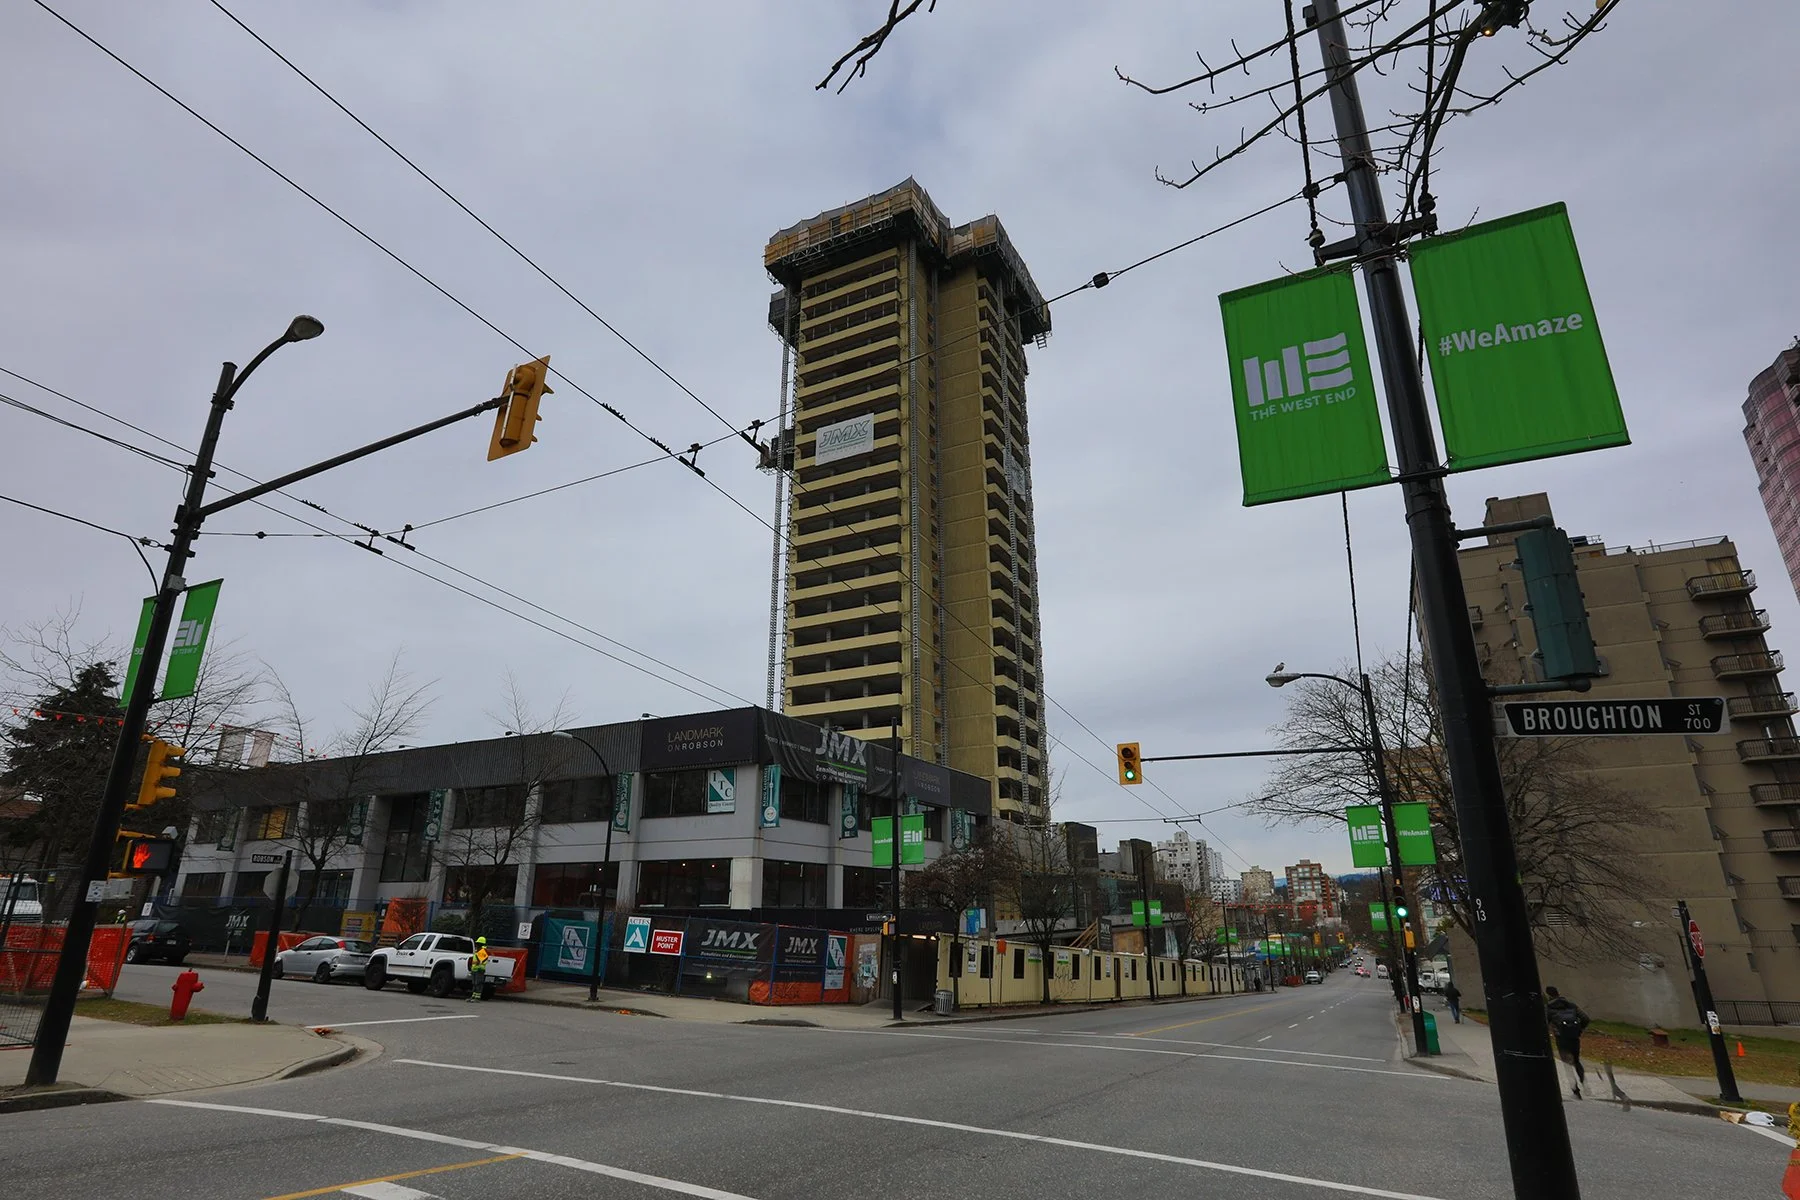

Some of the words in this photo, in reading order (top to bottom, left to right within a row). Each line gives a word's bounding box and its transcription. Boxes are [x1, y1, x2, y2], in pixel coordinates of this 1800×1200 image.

[1438, 312, 1584, 357] #WeAmaze
[1249, 404, 1277, 421] THE
[1280, 395, 1321, 413] WEST
[1325, 387, 1356, 405] END
[819, 420, 870, 448] JMX
[1522, 704, 1662, 731] BROUGHTON
[1688, 704, 1701, 716] ST
[1683, 717, 1712, 729] 700
[667, 727, 724, 743] LANDMARK
[667, 744, 680, 752] ON
[682, 740, 724, 750] ROBSON
[815, 727, 867, 767] JMX
[712, 772, 732, 798] ITC
[253, 855, 274, 863] ROBSON
[1475, 898, 1482, 909] 9
[225, 915, 250, 927] JMX
[1475, 910, 1487, 922] 13
[656, 935, 678, 943] MUSTER
[701, 929, 760, 949] JMX
[784, 936, 818, 954] JMX
